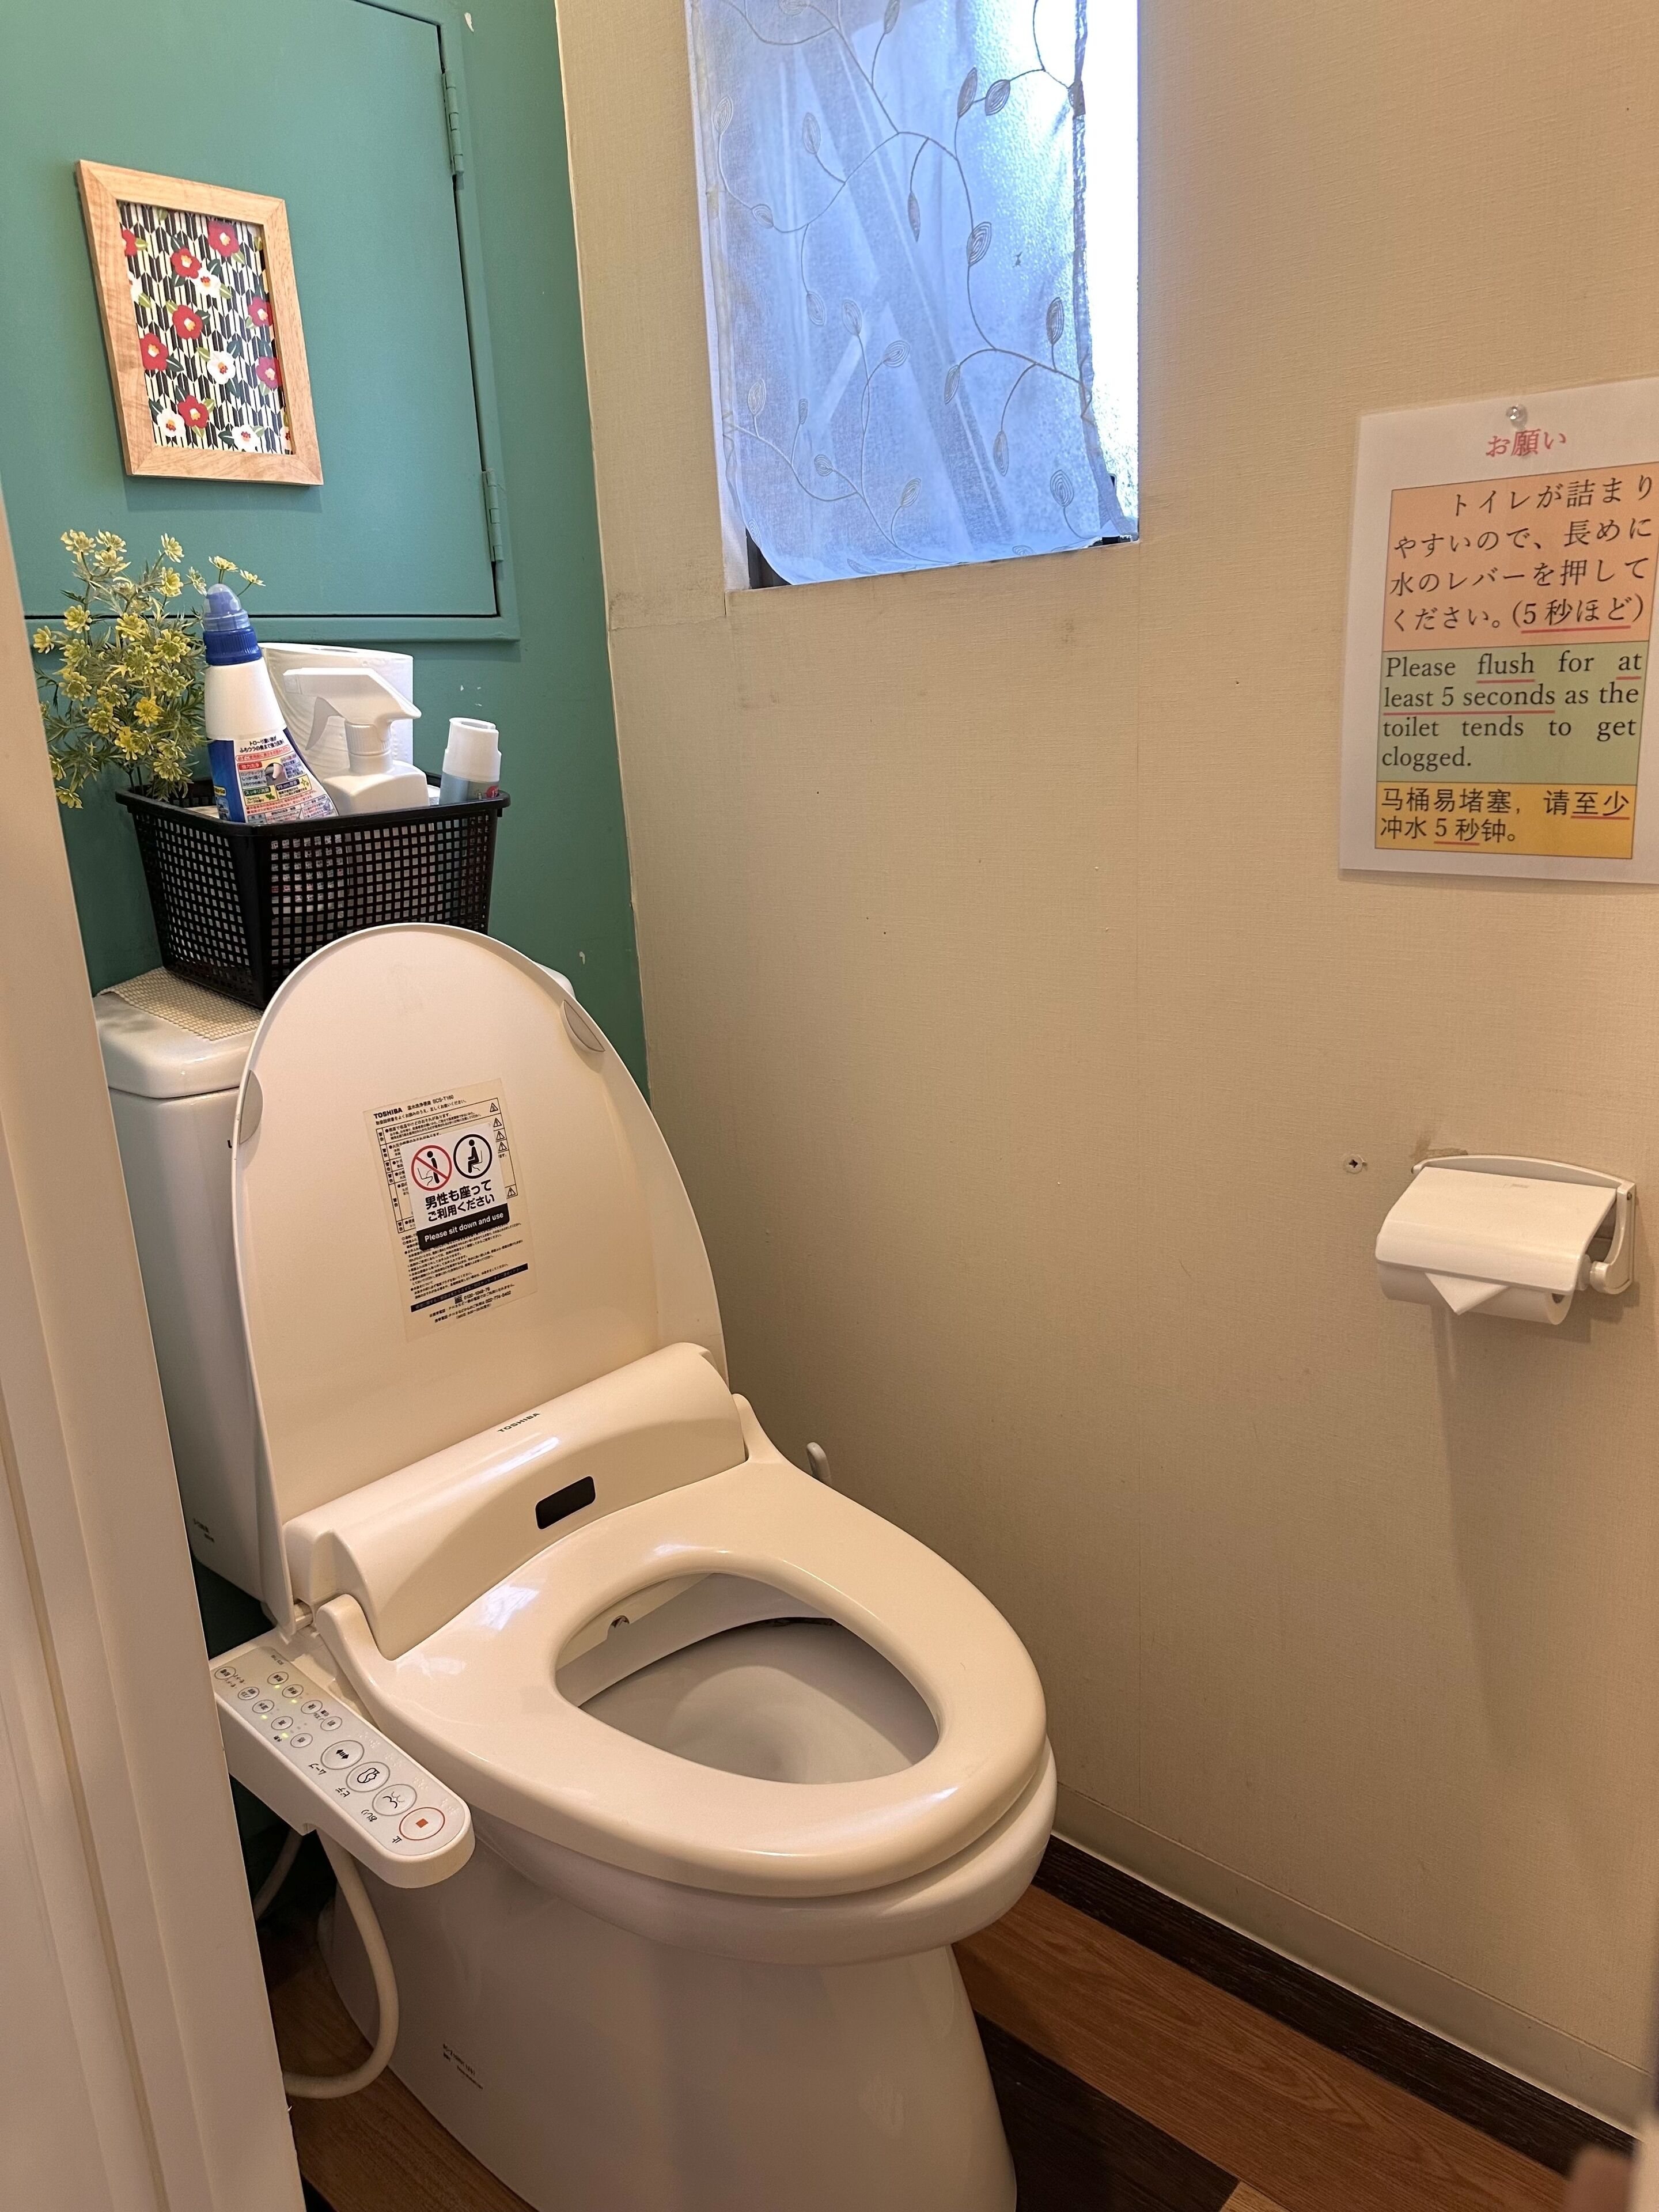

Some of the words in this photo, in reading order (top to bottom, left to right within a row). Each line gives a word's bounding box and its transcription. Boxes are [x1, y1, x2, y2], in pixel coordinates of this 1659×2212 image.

[1486, 429, 1566, 457] お願い
[1455, 475, 1652, 516] トイレが詰まり
[1390, 557, 1649, 596] 水のレバーを押して
[1386, 657, 1456, 677] Please
[1478, 652, 1535, 675] flush
[1558, 650, 1594, 672] for
[1618, 654, 1642, 671] at
[1384, 687, 1433, 707] least
[1441, 687, 1454, 706] 5
[1463, 683, 1555, 706] seconds
[1565, 688, 1589, 703] as
[1599, 681, 1638, 703] the
[1382, 717, 1440, 737] toilet
[1462, 715, 1524, 736] tends
[1549, 721, 1571, 736] to
[1597, 719, 1637, 741] get
[1382, 747, 1471, 771] clogged.
[373, 1107, 403, 1119] TOSHIBA
[425, 1179, 491, 1210] 男性も座って
[427, 1194, 495, 1222] ご利用ください
[424, 1231, 448, 1242] Please
[459, 1221, 477, 1231] down
[478, 1216, 490, 1225] and
[491, 1213, 504, 1221] use
[497, 1413, 540, 1432] TOSHIBA
[309, 1763, 327, 1775] ムーブ
[361, 1809, 377, 1822] おしり
